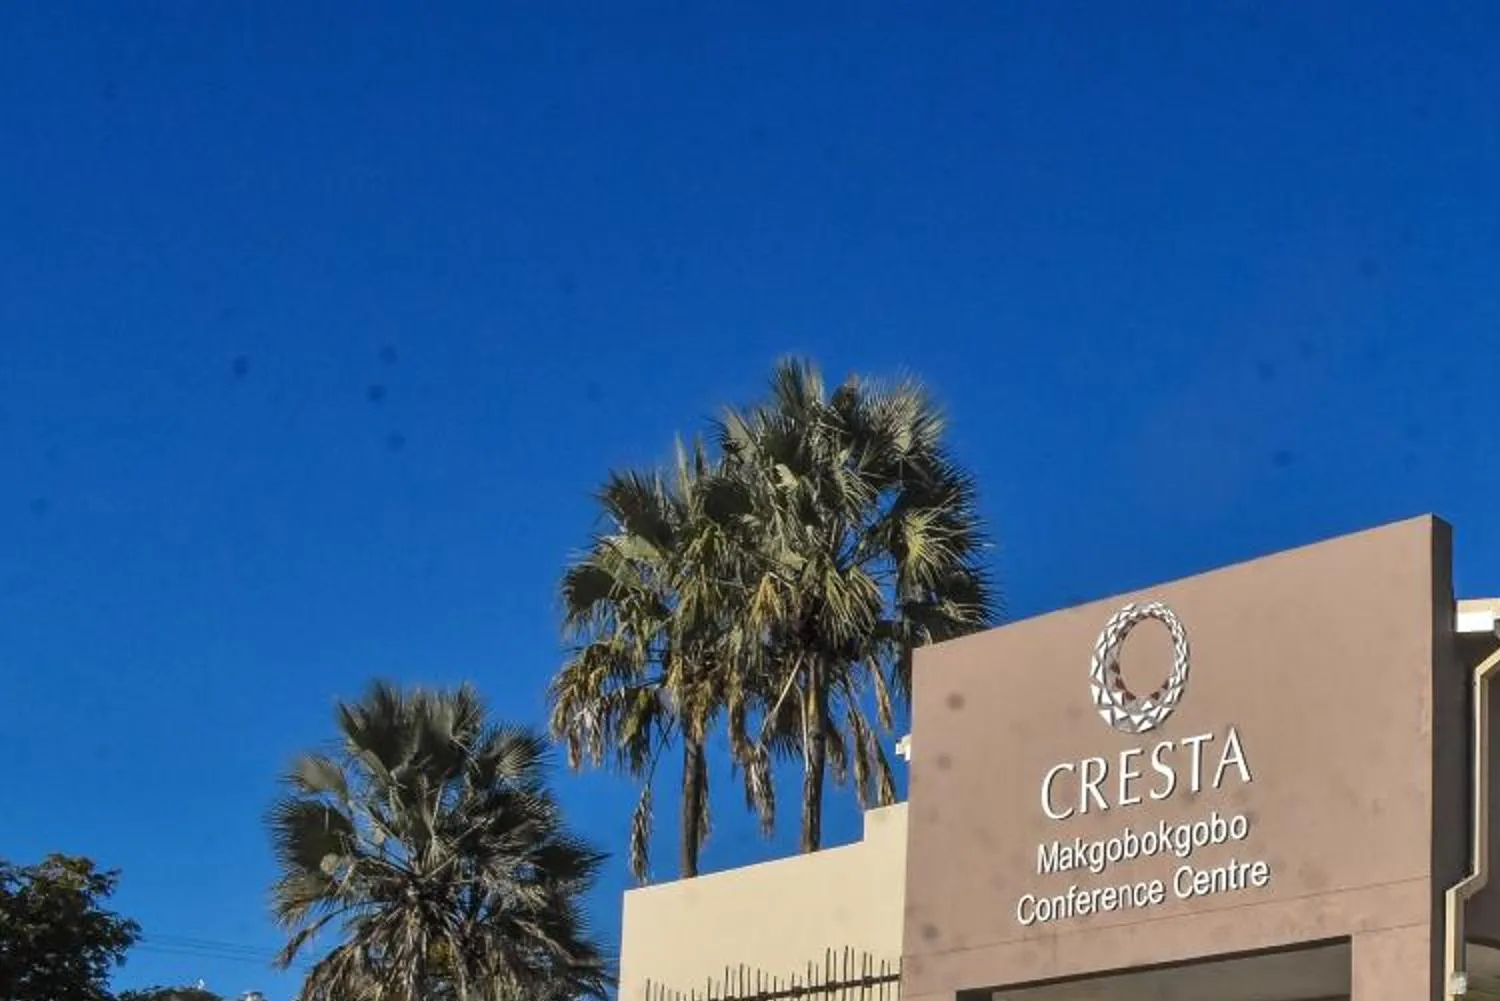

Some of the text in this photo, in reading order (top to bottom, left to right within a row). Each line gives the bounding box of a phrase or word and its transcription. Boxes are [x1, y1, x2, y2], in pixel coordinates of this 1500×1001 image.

[1041, 727, 1252, 820] CRESTA
[1037, 812, 1248, 875] Makgobokgobo
[1017, 859, 1270, 925] Conference Centre
